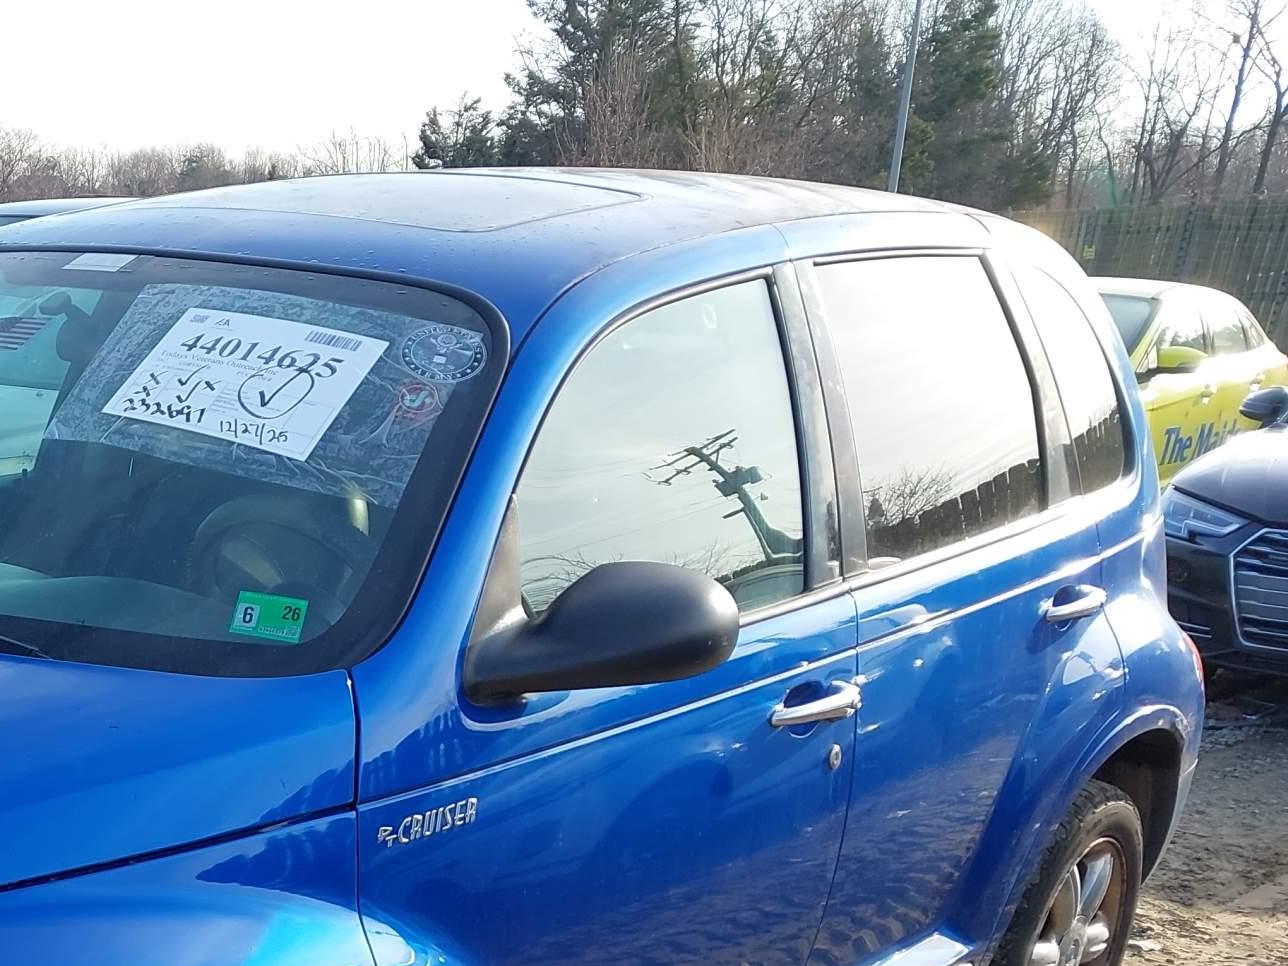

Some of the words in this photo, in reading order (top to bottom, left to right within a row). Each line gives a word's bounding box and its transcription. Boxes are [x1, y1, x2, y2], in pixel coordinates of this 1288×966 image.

[180, 333, 344, 378] 44014625
[123, 398, 206, 424] 232697
[220, 419, 289, 446] 12/27/25
[1159, 426, 1193, 466] The
[242, 606, 254, 624] 6
[282, 605, 301, 622] 26
[397, 797, 478, 843] CRUISER
